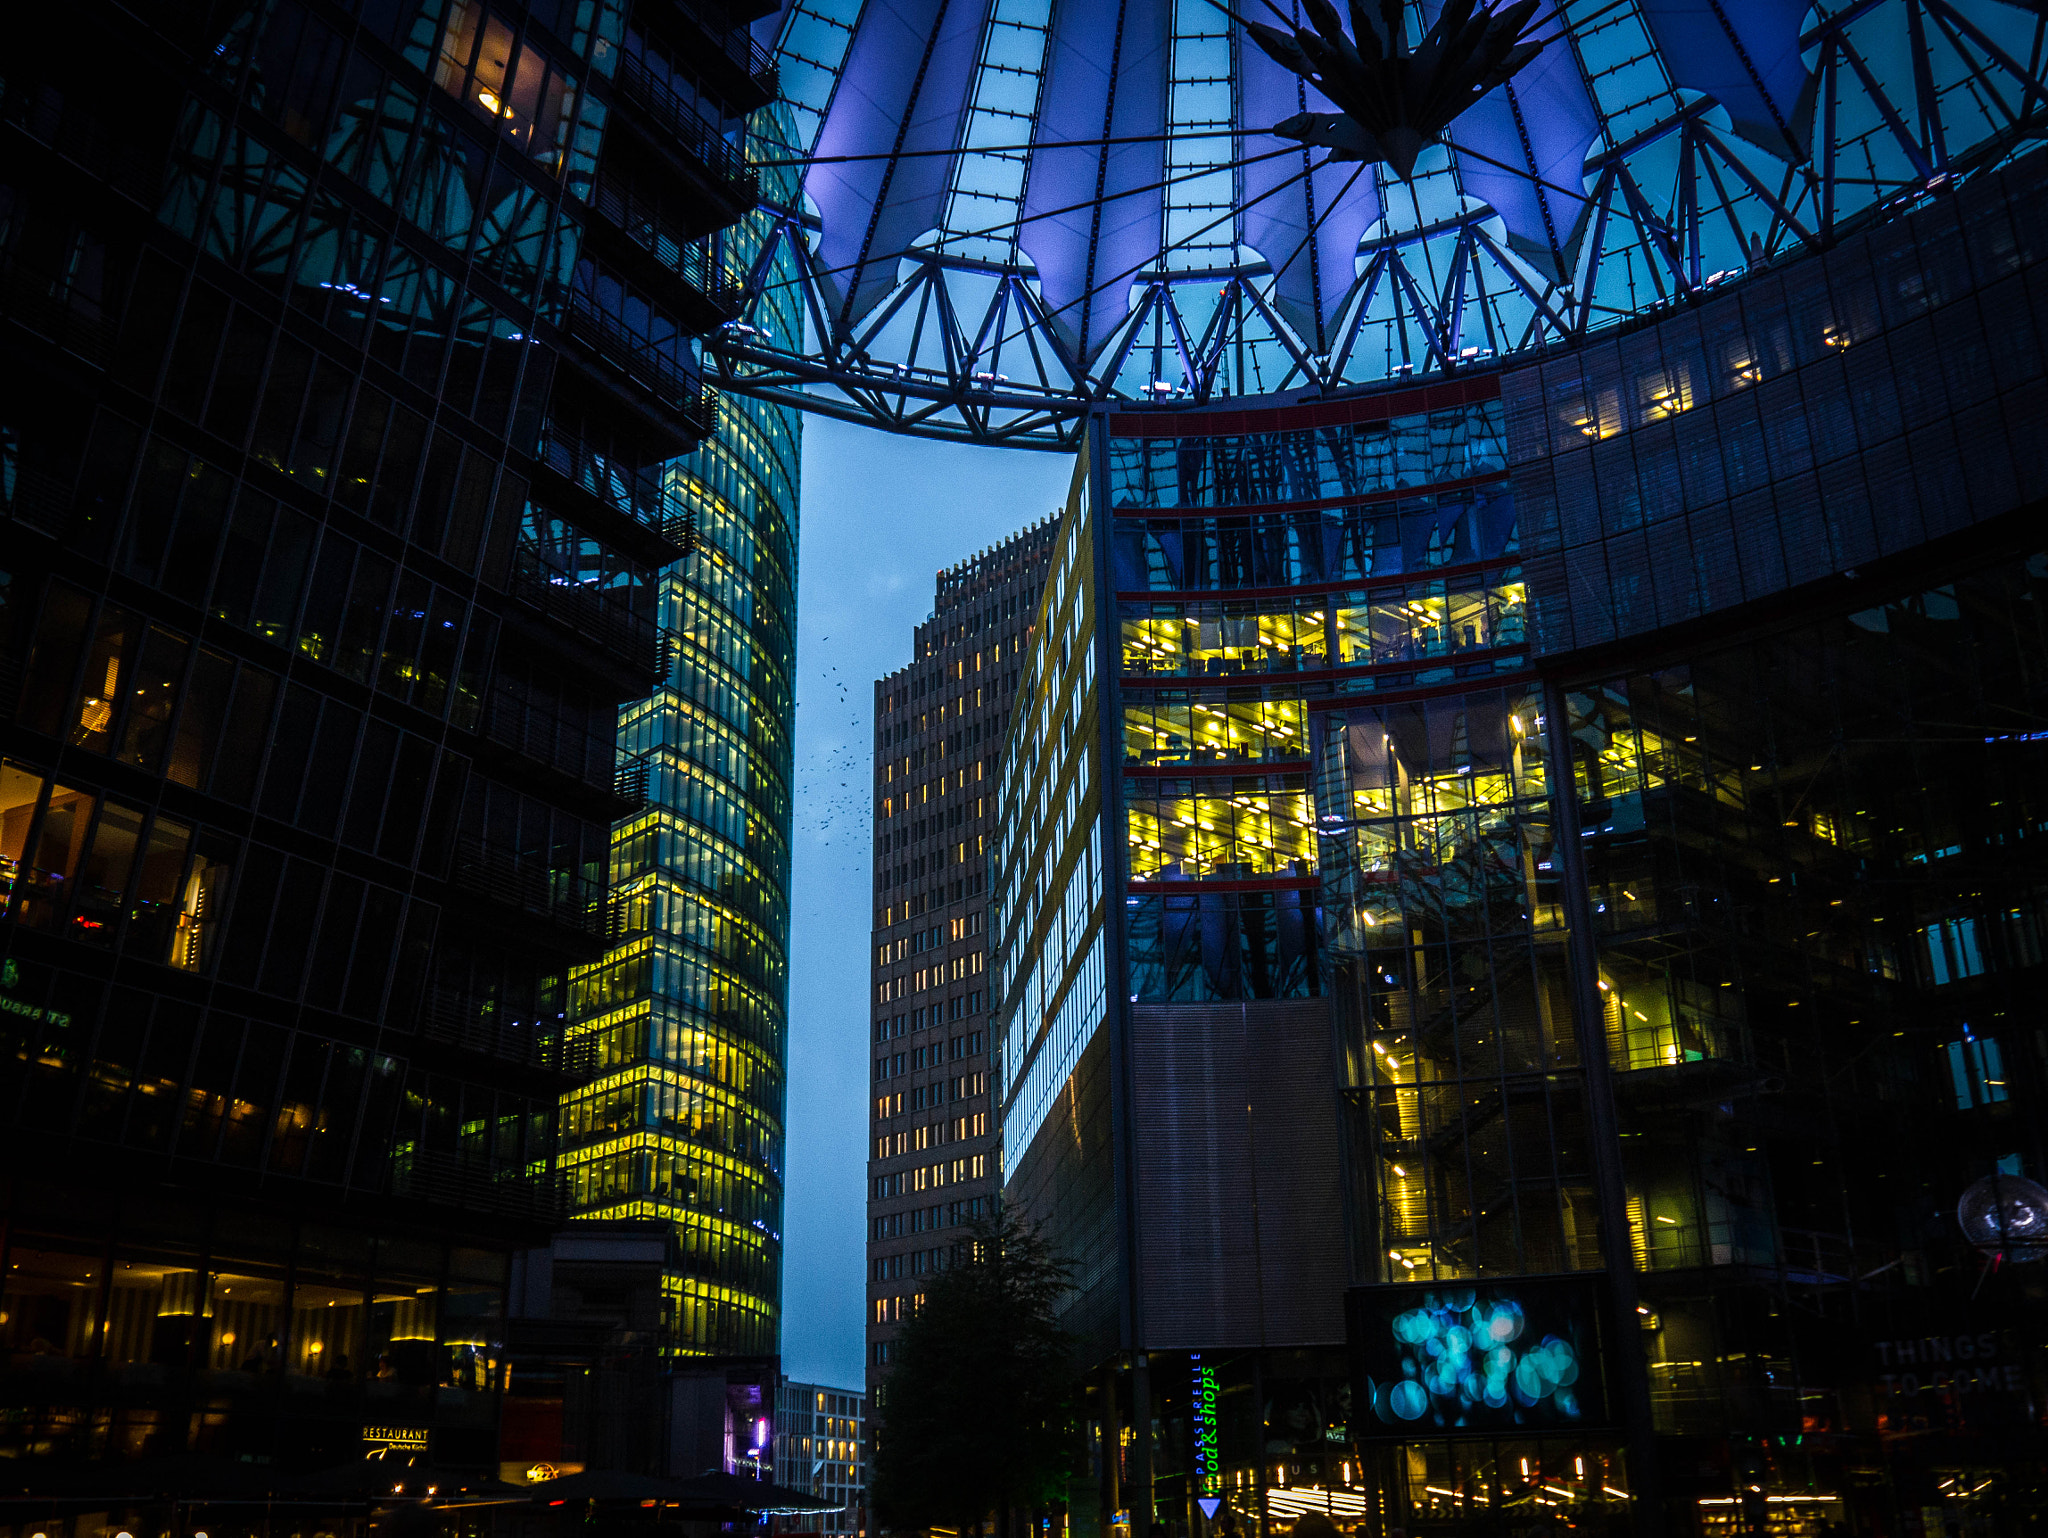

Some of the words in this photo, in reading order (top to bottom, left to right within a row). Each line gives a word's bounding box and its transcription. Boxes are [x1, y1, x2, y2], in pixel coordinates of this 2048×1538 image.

[1873, 1333, 1997, 1366] THINGS
[1880, 1373, 1919, 1397] TO
[1934, 1365, 2024, 1396] COME
[1190, 1354, 1206, 1475] PASSERELLE
[363, 1427, 430, 1439] RESTAURANT
